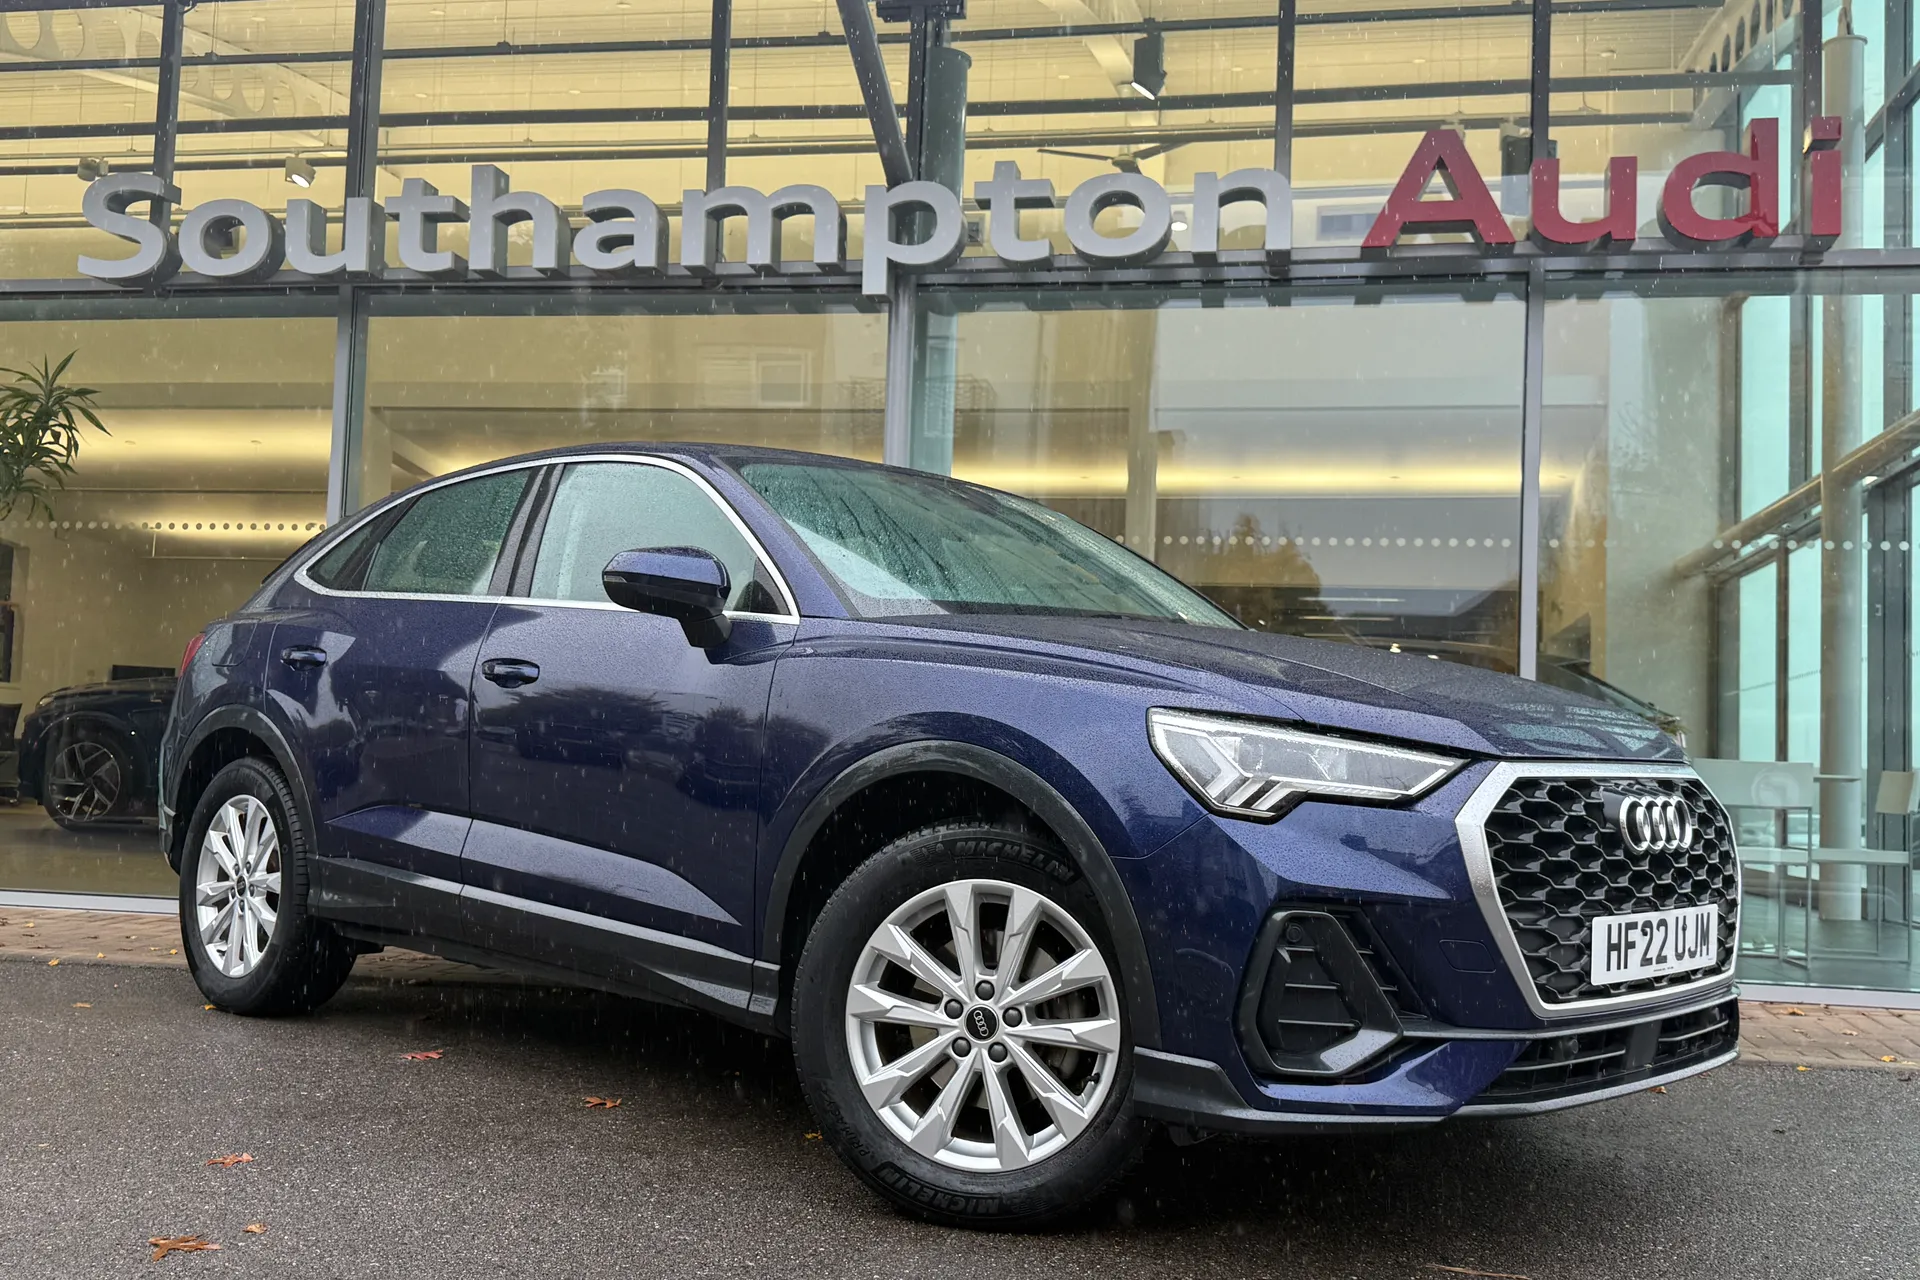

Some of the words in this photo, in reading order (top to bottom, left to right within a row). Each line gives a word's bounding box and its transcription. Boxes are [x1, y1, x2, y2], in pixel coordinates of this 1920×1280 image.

[78, 165, 1292, 296] Southampton
[1362, 116, 1842, 248] Audi
[955, 840, 1076, 883] MICHELIN
[1605, 918, 1669, 972] HF22
[1674, 911, 1711, 961] UJM
[878, 1167, 999, 1214] MICHELIN
